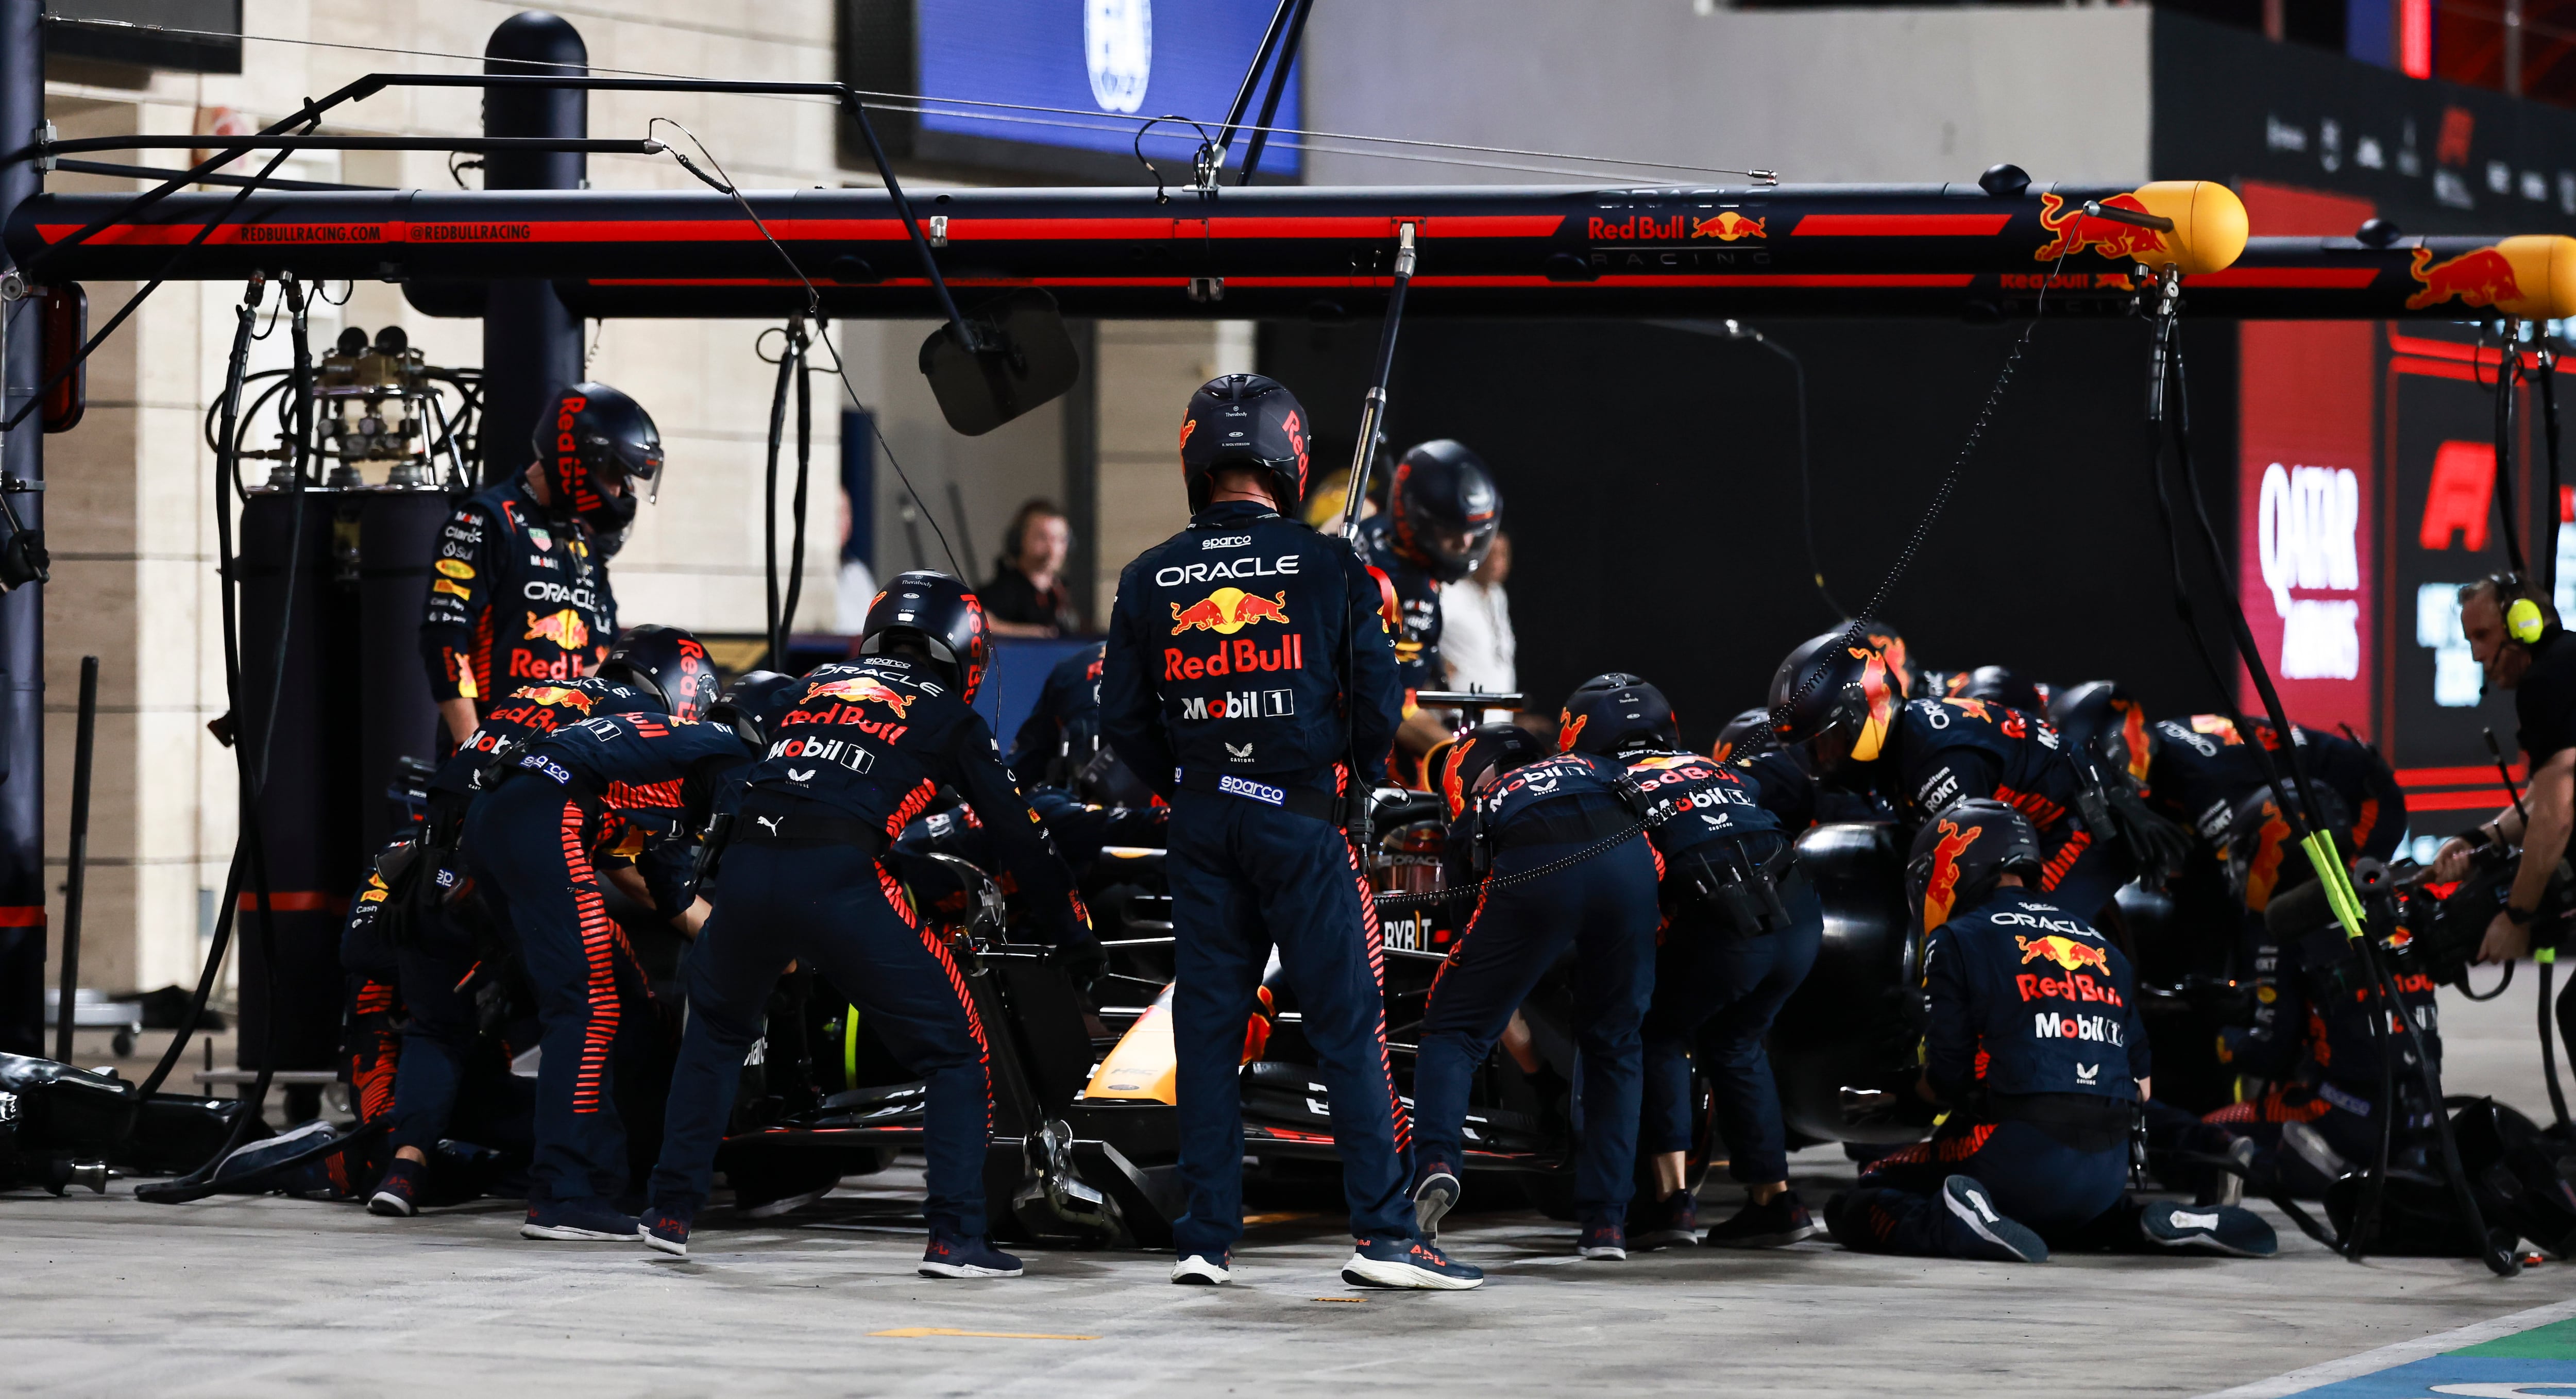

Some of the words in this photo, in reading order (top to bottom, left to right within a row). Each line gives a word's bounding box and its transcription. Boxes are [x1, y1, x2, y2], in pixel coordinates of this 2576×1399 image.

[241, 226, 380, 241] REDBULLRACING.COM
[412, 225, 530, 240] @REDBULLRACING
[1588, 215, 1635, 239] Red
[1639, 215, 1684, 239] Bull
[1591, 253, 1770, 265] RACING
[557, 397, 587, 452] Red
[1202, 535, 1251, 550] sparco
[902, 580, 933, 588] Therabody
[1156, 554, 1300, 587] ORACLE
[509, 648, 568, 680] Red
[863, 657, 911, 669] sparco
[1164, 640, 1230, 681] Red
[1233, 634, 1302, 672] Bull
[811, 665, 944, 697] ORACLE
[1181, 691, 1258, 719] Mobil
[765, 736, 844, 762] Mobil
[1219, 776, 1283, 805] sparco
[1490, 766, 1563, 813] Mobil
[1640, 769, 1686, 792] ed
[1925, 775, 1958, 813] ROKT
[1393, 855, 1443, 867] ORACL
[357, 905, 378, 914] Cash
[2015, 970, 2076, 1002] Red
[2035, 1012, 2104, 1042] Mobil
[1410, 1244, 1447, 1267] APL
